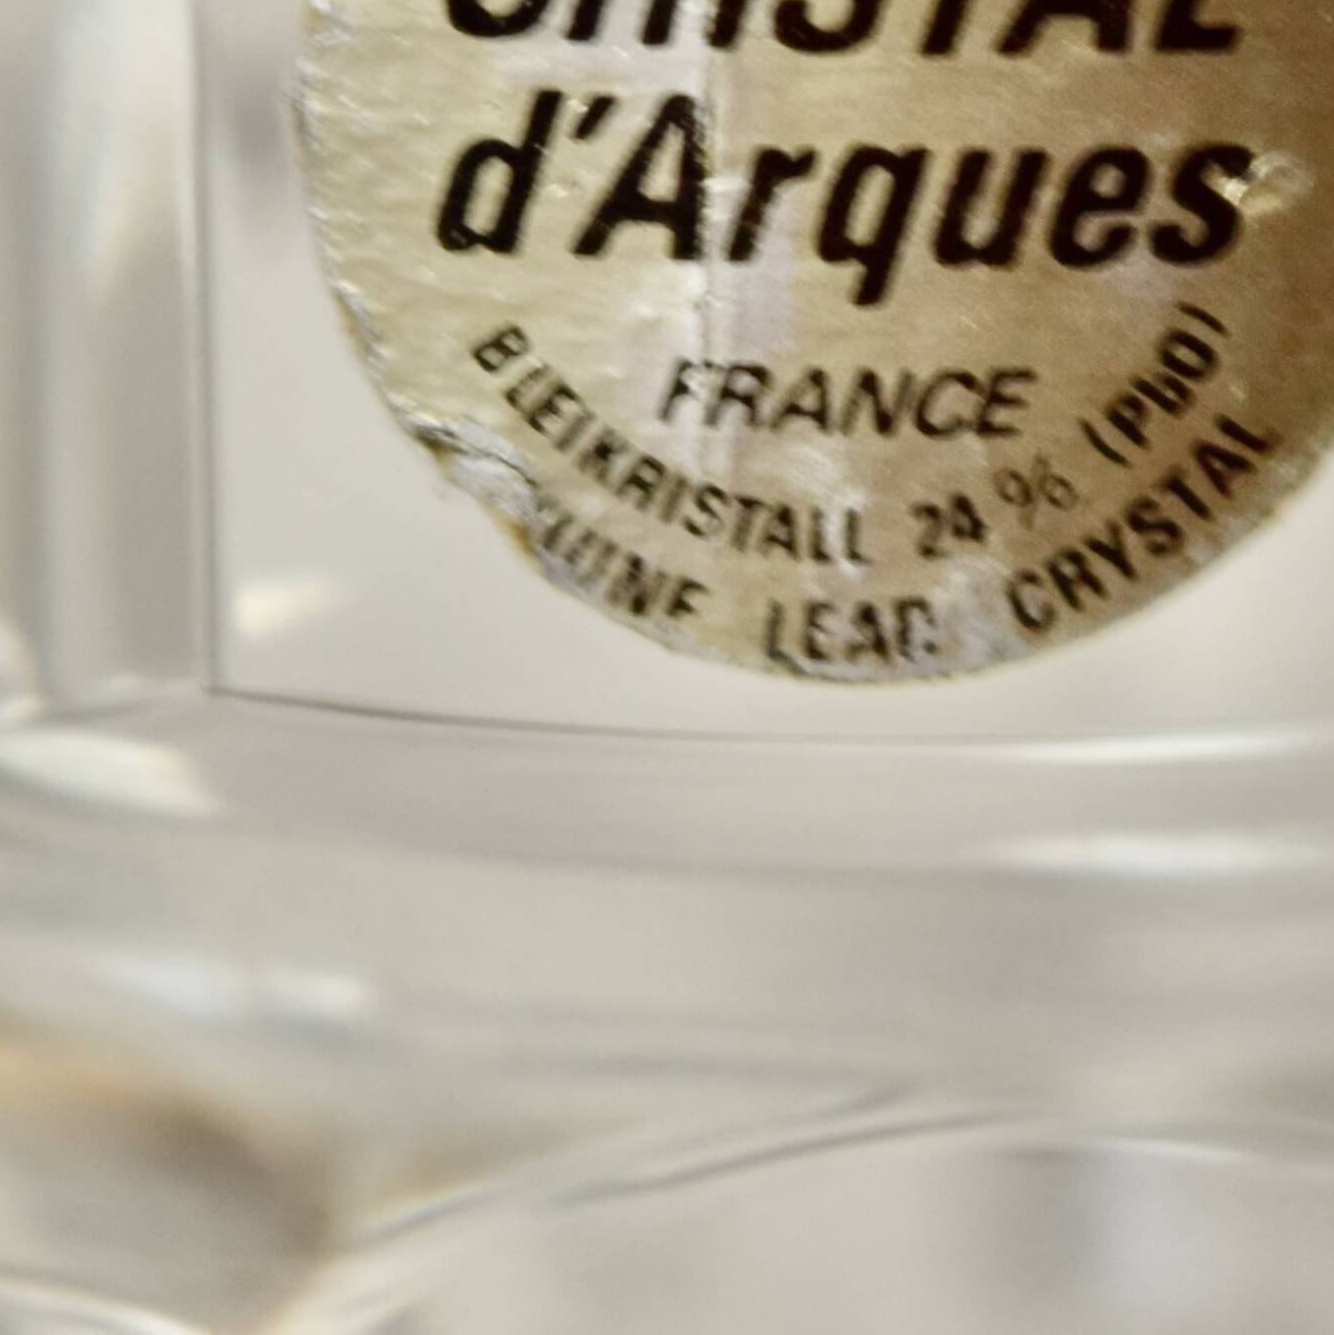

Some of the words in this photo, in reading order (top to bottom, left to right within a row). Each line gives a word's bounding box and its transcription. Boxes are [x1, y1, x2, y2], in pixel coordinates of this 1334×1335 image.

[434, 88, 1255, 308] d'Arques
[472, 322, 872, 564] BLEIKRISTALL
[910, 492, 986, 561] 24
[657, 359, 1040, 440] FRANCE
[1003, 413, 1277, 636] CRYSTAL
